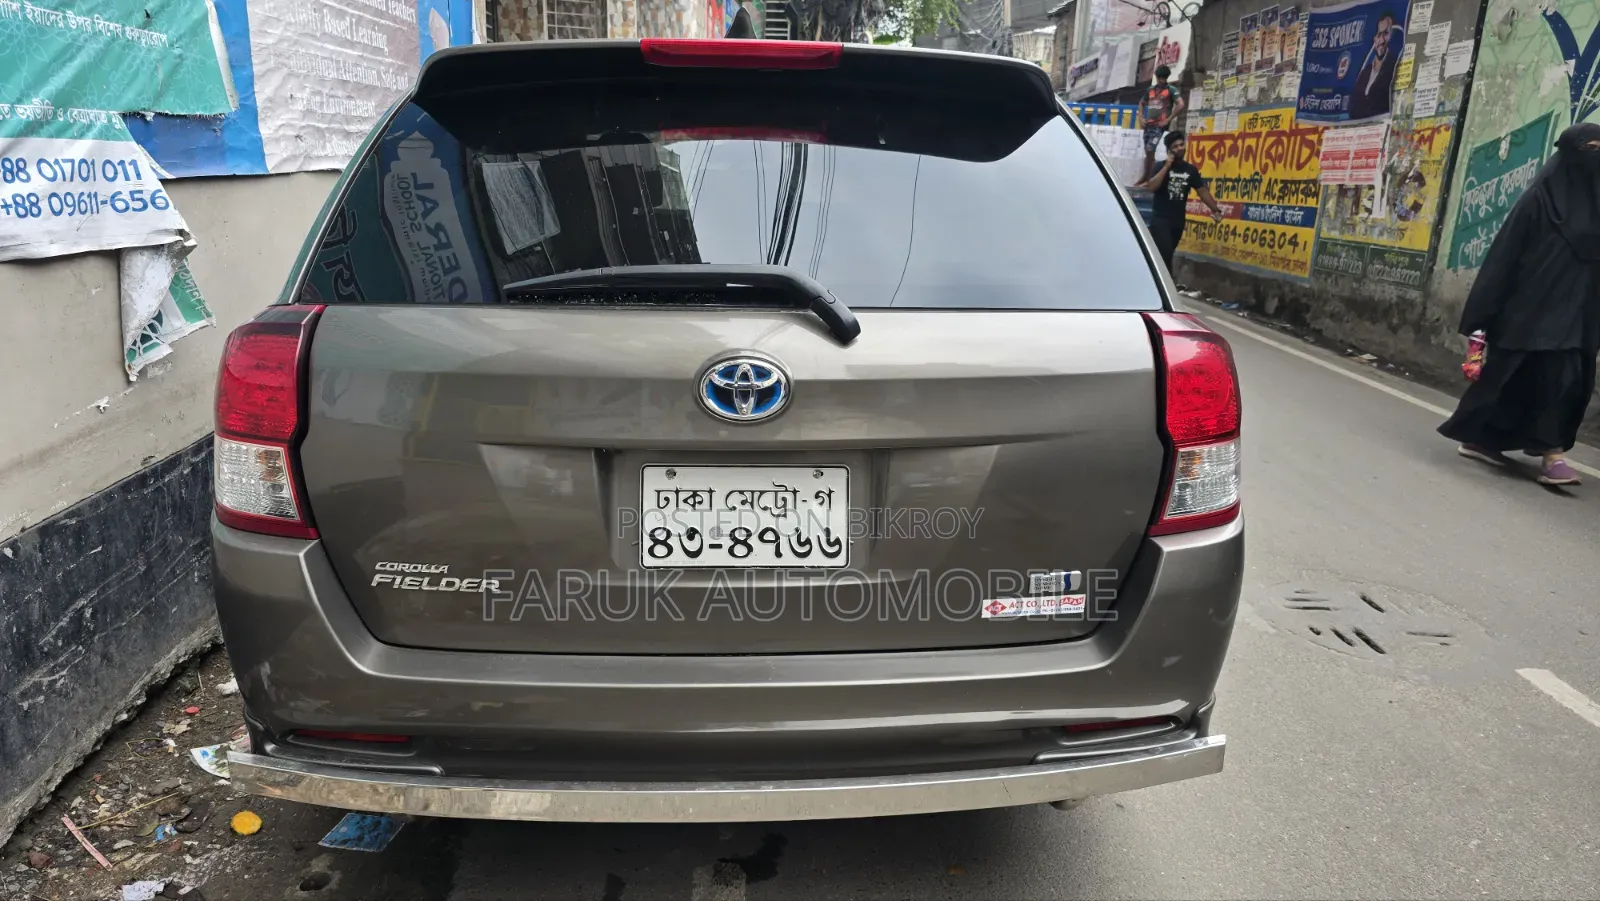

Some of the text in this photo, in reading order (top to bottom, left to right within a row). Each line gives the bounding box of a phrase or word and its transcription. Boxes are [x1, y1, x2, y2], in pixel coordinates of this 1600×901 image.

[66, 10, 92, 34] উপর
[94, 14, 122, 39] বিশেষ
[323, 9, 351, 40] Based
[351, 18, 389, 56] Learning
[338, 56, 381, 88] Attention,
[381, 66, 397, 91] Safe
[36, 157, 97, 184] 01701
[1264, 177, 1278, 201] AC
[654, 486, 717, 512] ঢাকা
[647, 525, 844, 559] ৪৩-৪৭৬৬
[374, 561, 449, 574] COROLLA
[370, 573, 503, 594] FIELDER
